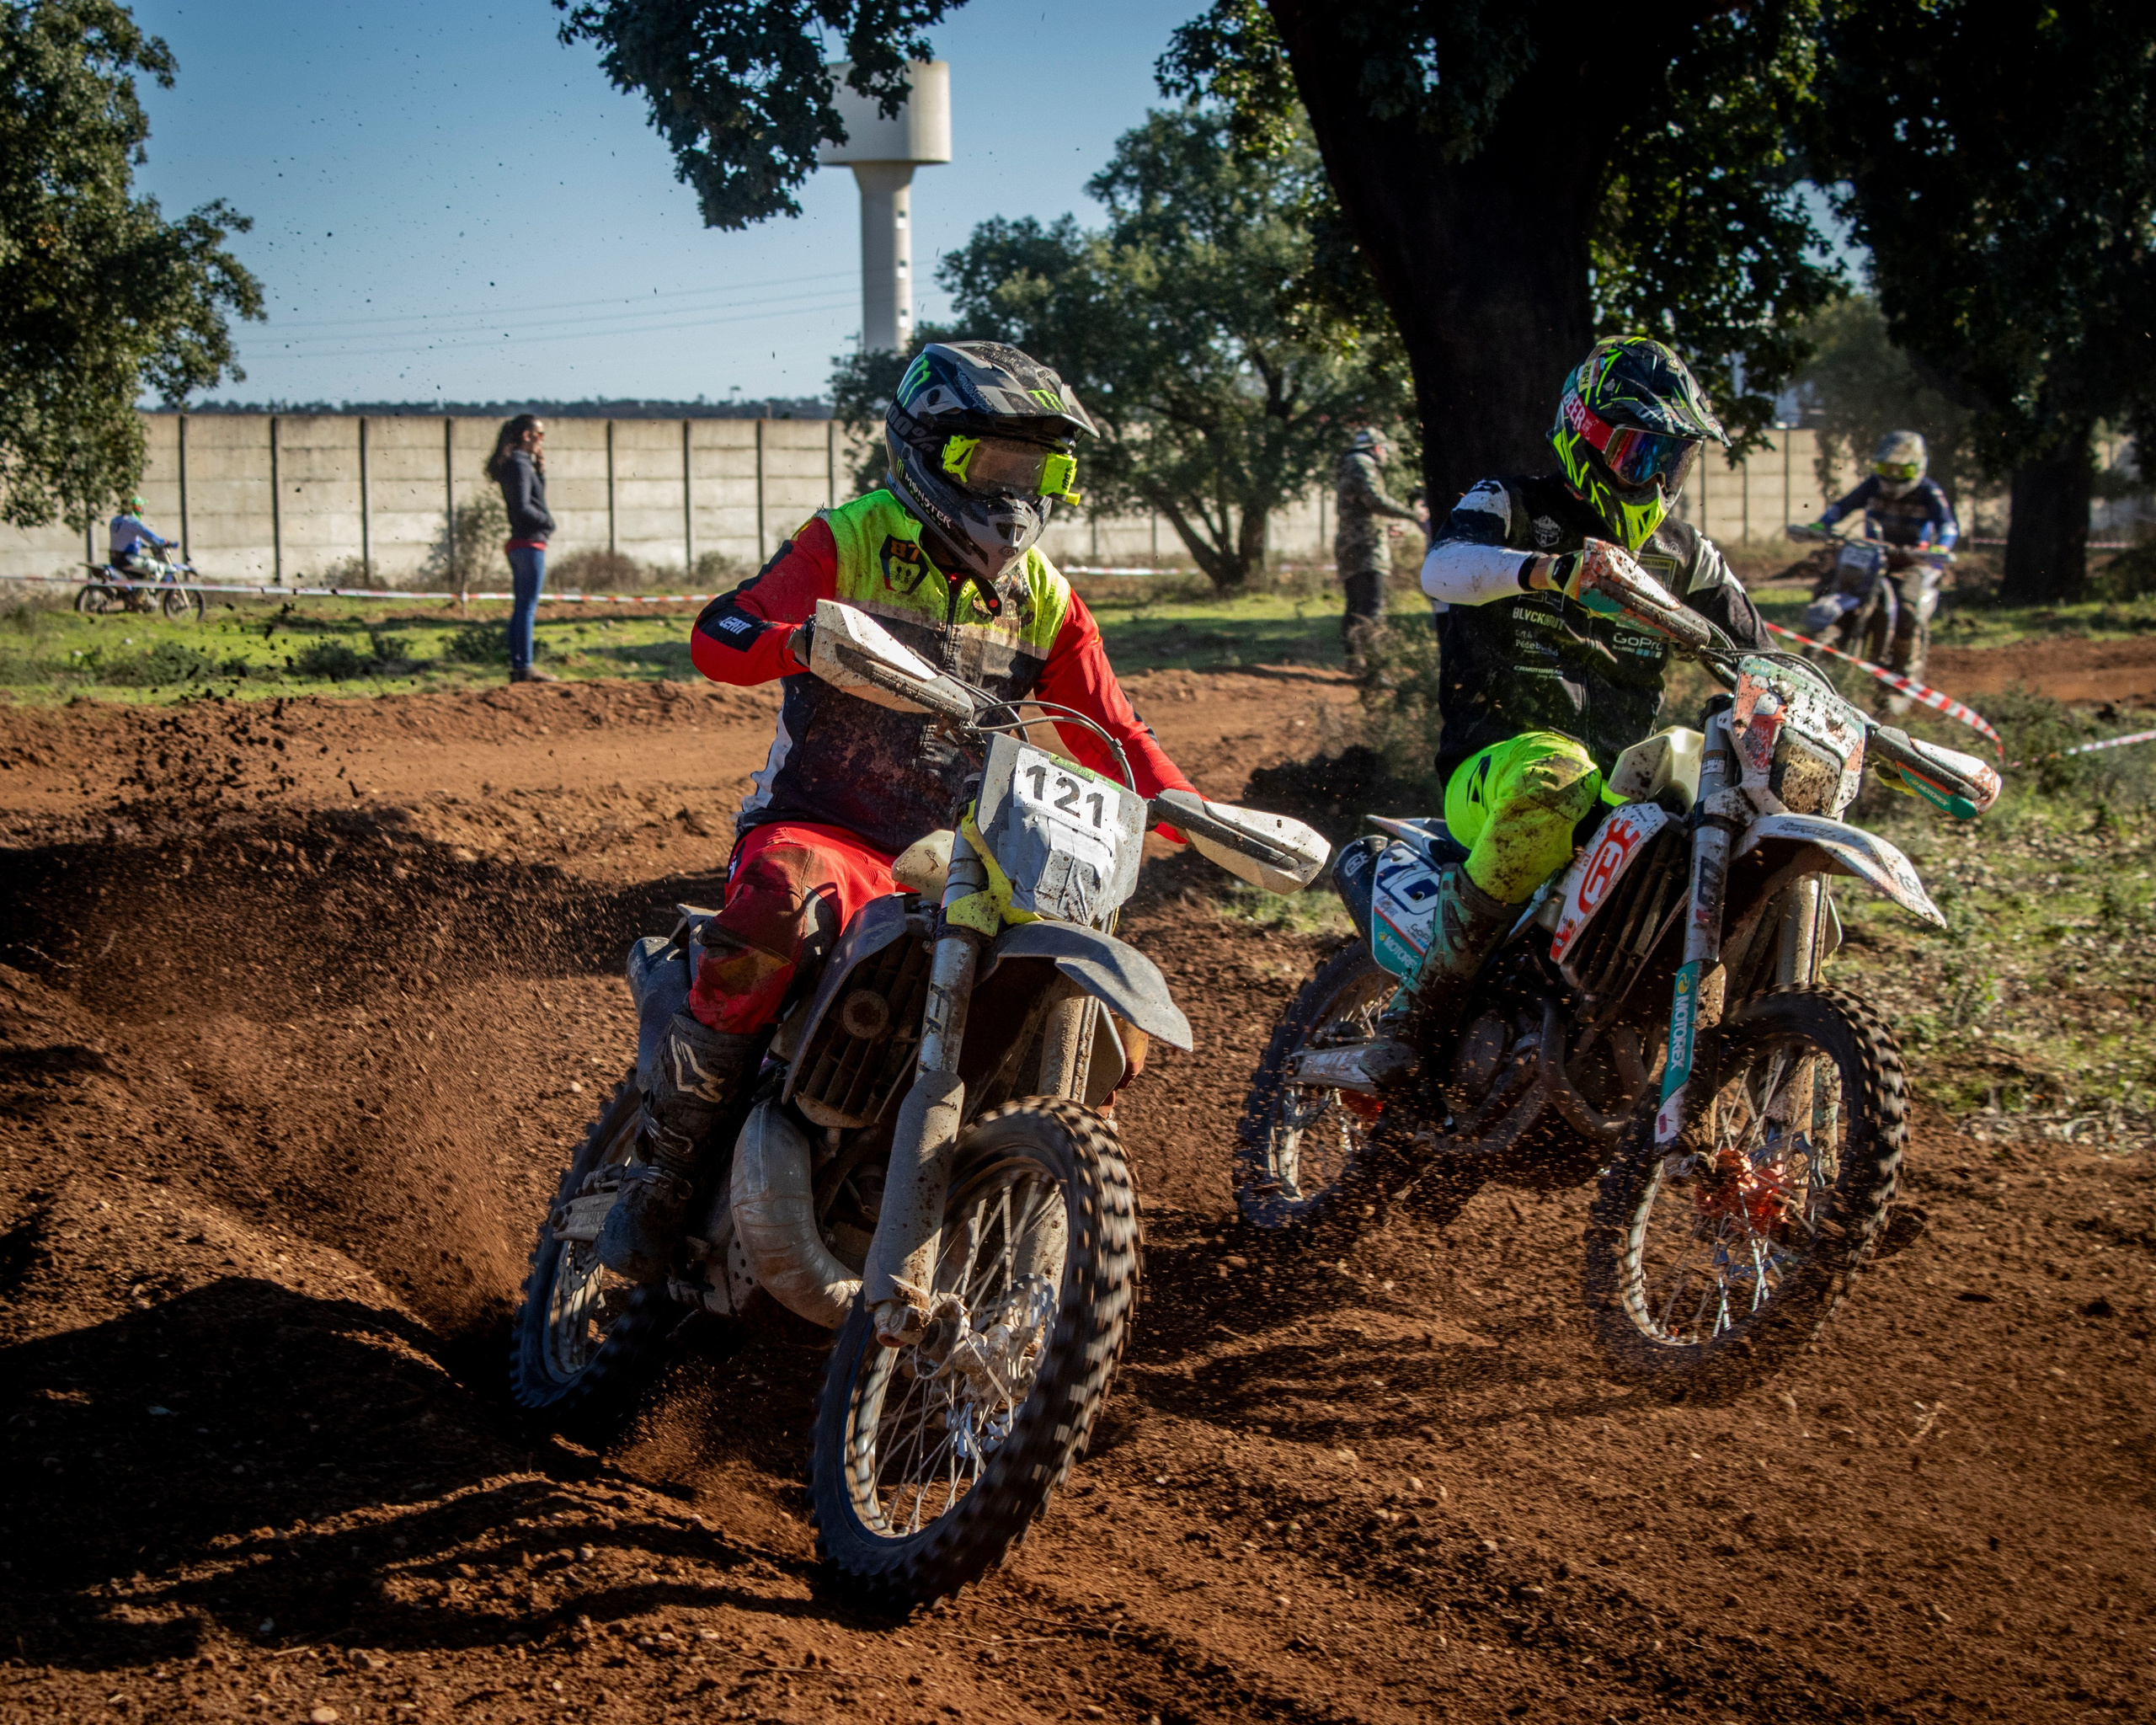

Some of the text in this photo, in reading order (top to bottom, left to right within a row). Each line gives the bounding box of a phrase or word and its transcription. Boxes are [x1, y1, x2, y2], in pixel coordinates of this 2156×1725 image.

[887, 403, 941, 453] 00%
[1562, 387, 1587, 431] BEER
[905, 472, 953, 530] MONSTER
[890, 539, 921, 563] 87
[718, 616, 752, 635] LEATT
[1613, 632, 1663, 651] GoPro
[1026, 764, 1105, 829] 121
[1670, 994, 1690, 1071] MOTOREX
